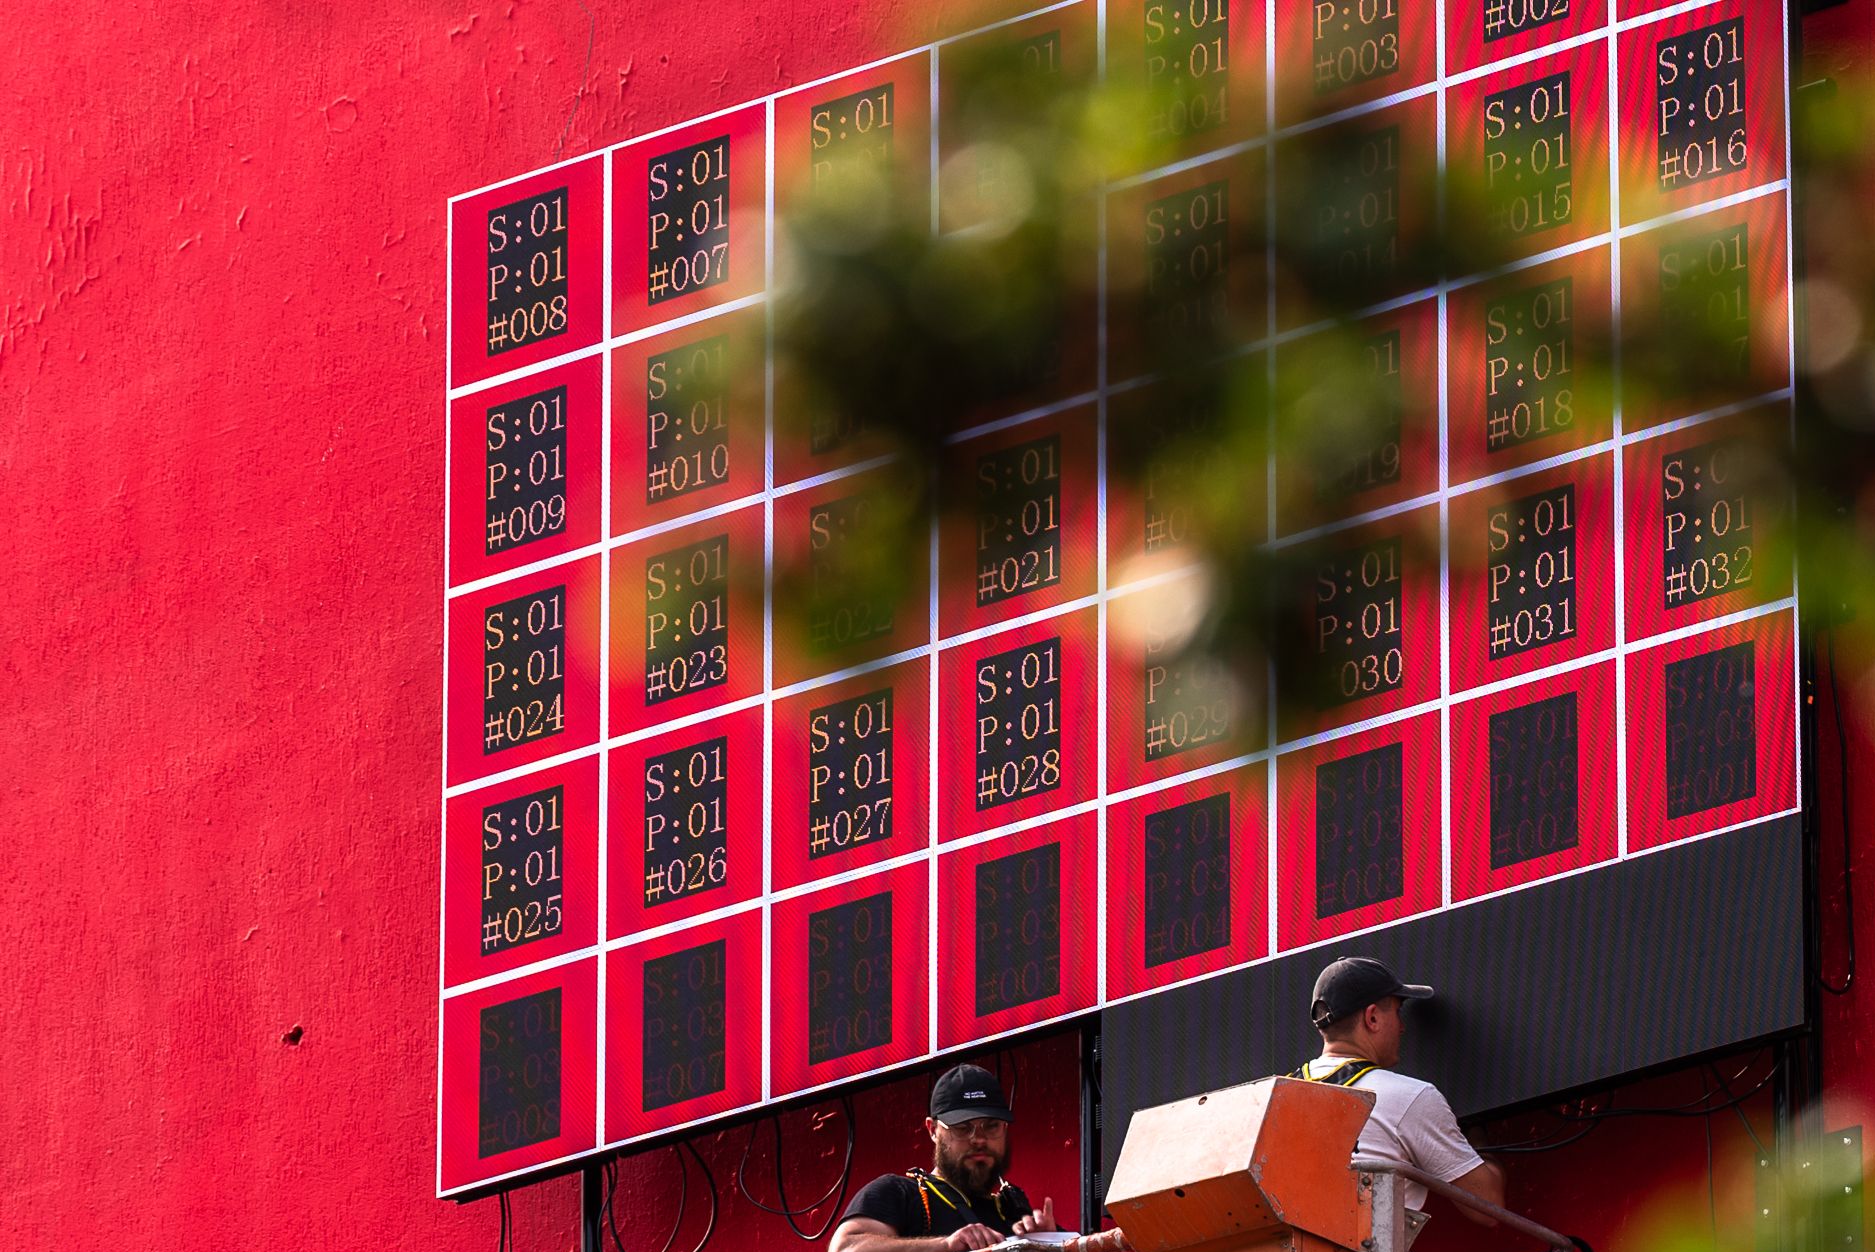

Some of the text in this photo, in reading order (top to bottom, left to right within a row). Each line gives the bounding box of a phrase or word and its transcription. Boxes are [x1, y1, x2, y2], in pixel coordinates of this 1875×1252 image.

[1144, 0, 1225, 44] S:01
[1144, 36, 1226, 94] P:01
[1314, 32, 1397, 90] #003
[1659, 26, 1743, 86] S:01
[813, 92, 892, 150] S:01
[1486, 80, 1569, 140] S:01
[1659, 78, 1744, 137] P:01
[650, 144, 728, 202] S:01
[1486, 132, 1569, 191] P:01
[1660, 129, 1745, 187] #016
[489, 196, 566, 253] S:01
[650, 194, 728, 251] P:01
[1145, 187, 1226, 246] S:01
[488, 245, 566, 302] P:01
[649, 241, 729, 299] #007
[488, 294, 566, 350] #008
[1487, 286, 1571, 345] S:01
[649, 343, 727, 400] S:01
[1488, 338, 1572, 396] P:01
[487, 394, 565, 451] S:01
[648, 393, 727, 450] P:01
[1488, 389, 1573, 447] #018
[487, 444, 564, 500] P:01
[648, 443, 728, 499] #010
[977, 442, 1058, 500] S:01
[1339, 441, 1399, 491] 019
[1664, 446, 1729, 500] S:0
[486, 493, 565, 549] #009
[811, 499, 873, 551] S:0
[977, 493, 1058, 551] P:01
[1489, 493, 1573, 552] S:01
[1664, 493, 1750, 552] P:01
[647, 543, 726, 601] S:01
[977, 544, 1058, 600] #021
[1316, 544, 1399, 603] S:01
[1489, 545, 1574, 603] P:01
[1665, 545, 1751, 603] #032
[485, 593, 563, 650] S:01
[647, 594, 726, 650] P:01
[1317, 596, 1400, 654] P:01
[1490, 597, 1574, 654] #031
[485, 643, 563, 699] P:01
[647, 644, 727, 700] #023
[977, 646, 1058, 704] S:01
[1340, 648, 1401, 698] 030
[1666, 650, 1752, 710] S:01
[484, 693, 563, 748] #024
[811, 696, 891, 753] S:01
[977, 697, 1058, 755] P:01
[1491, 701, 1575, 760] S:01
[1667, 703, 1752, 762] P:03
[646, 745, 725, 802] S:01
[810, 747, 891, 804] P:01
[977, 748, 1059, 805] #028
[1318, 752, 1401, 811] S:01
[1491, 754, 1576, 812] P:03
[1668, 755, 1753, 813] #001
[483, 794, 561, 851] S:01
[646, 796, 725, 852] P:01
[810, 796, 891, 854] #027
[1146, 802, 1229, 860] S:01
[1318, 804, 1401, 862] P:03
[1492, 806, 1577, 863] #002
[483, 844, 561, 900] P:01
[645, 846, 725, 902] #026
[977, 851, 1058, 909] S:01
[1146, 854, 1229, 911] P:03
[1318, 856, 1402, 913] #003
[482, 893, 562, 950] #025
[810, 900, 890, 958] S:01
[977, 903, 1058, 960] P:03
[1147, 905, 1230, 962] #004
[645, 948, 724, 1005] S:01
[810, 952, 890, 1008] P:03
[977, 953, 1059, 1011] #005
[481, 996, 560, 1053] S:01
[644, 1000, 724, 1056] P:03
[810, 1002, 891, 1058] #006
[481, 1047, 560, 1103] P:03
[644, 1049, 724, 1106] #007
[480, 1097, 560, 1153] #008
